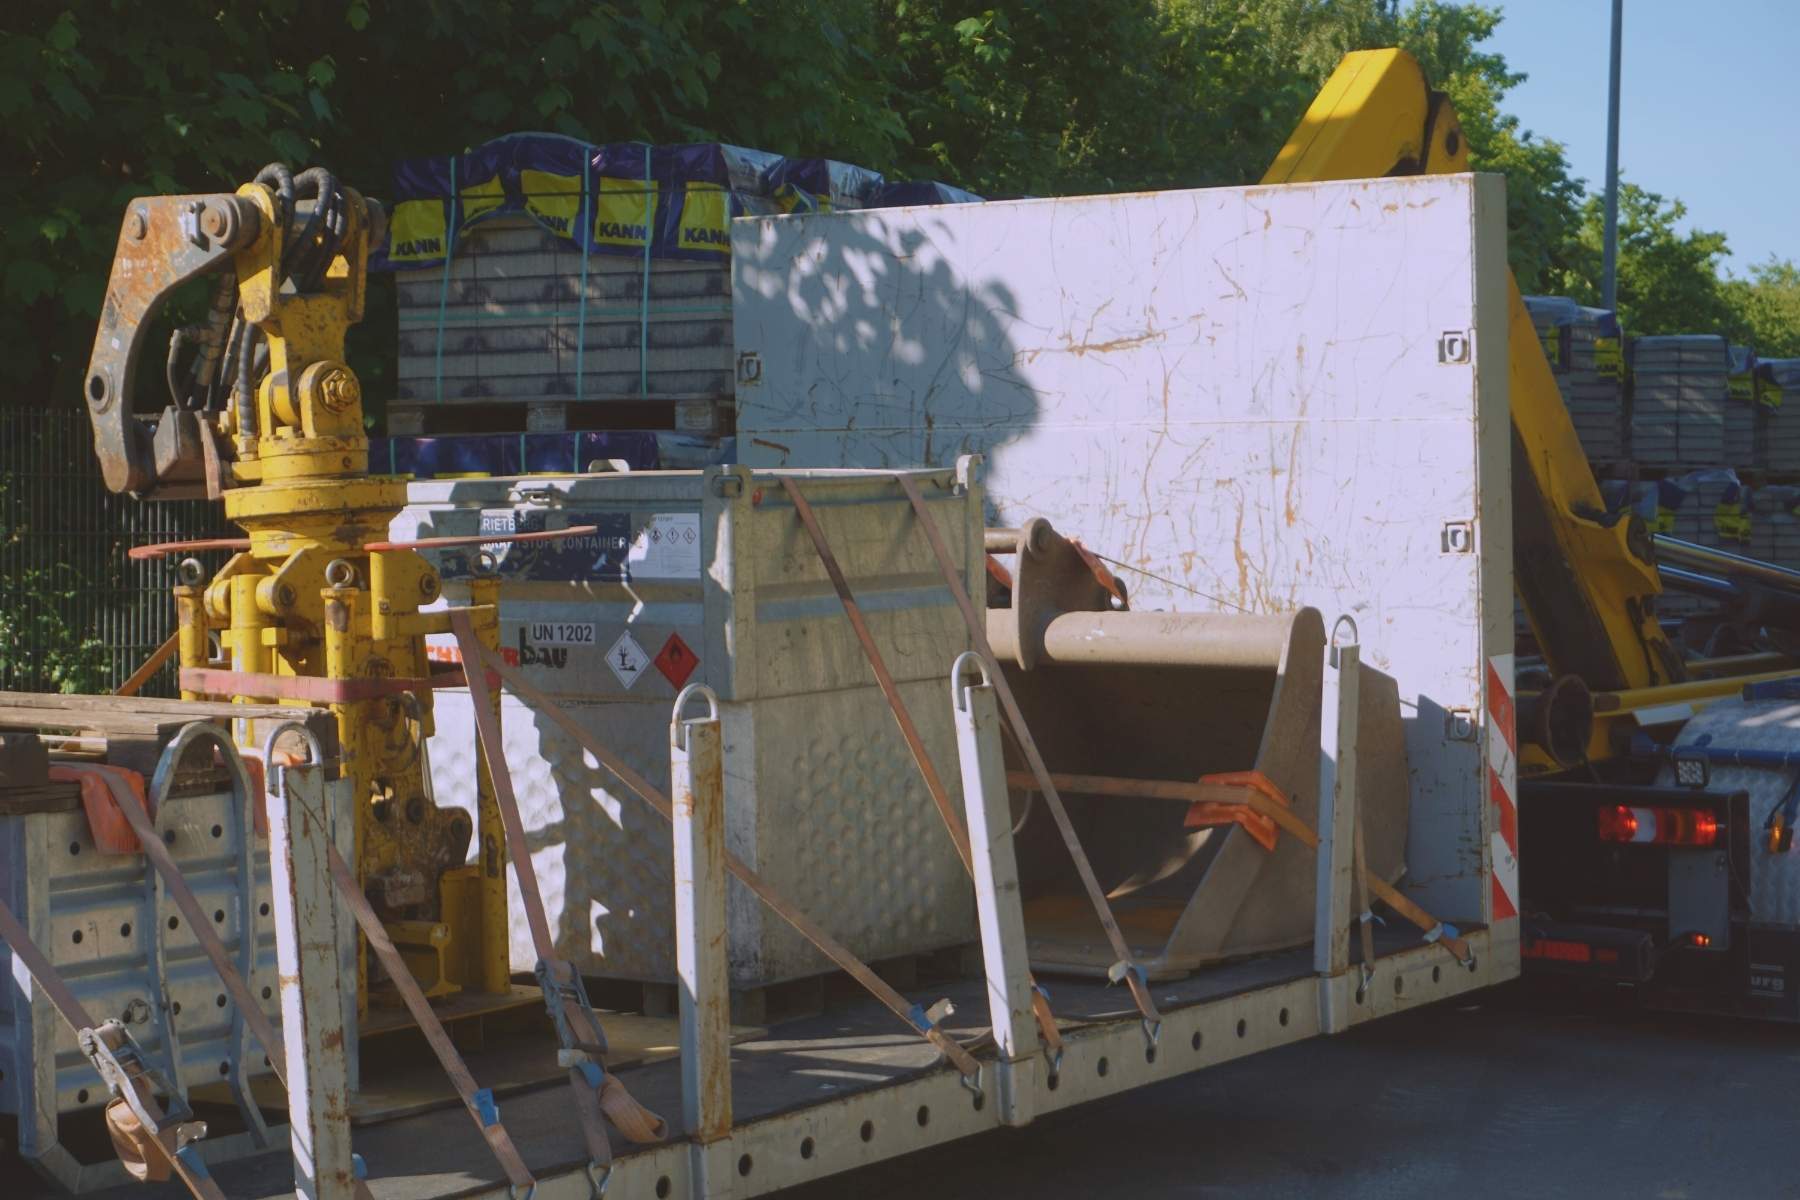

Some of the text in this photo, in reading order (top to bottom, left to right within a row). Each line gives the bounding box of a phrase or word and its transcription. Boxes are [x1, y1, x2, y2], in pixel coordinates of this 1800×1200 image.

[600, 221, 647, 241] KANN
[395, 238, 441, 256] KANN
[533, 624, 593, 642] UN 1202
